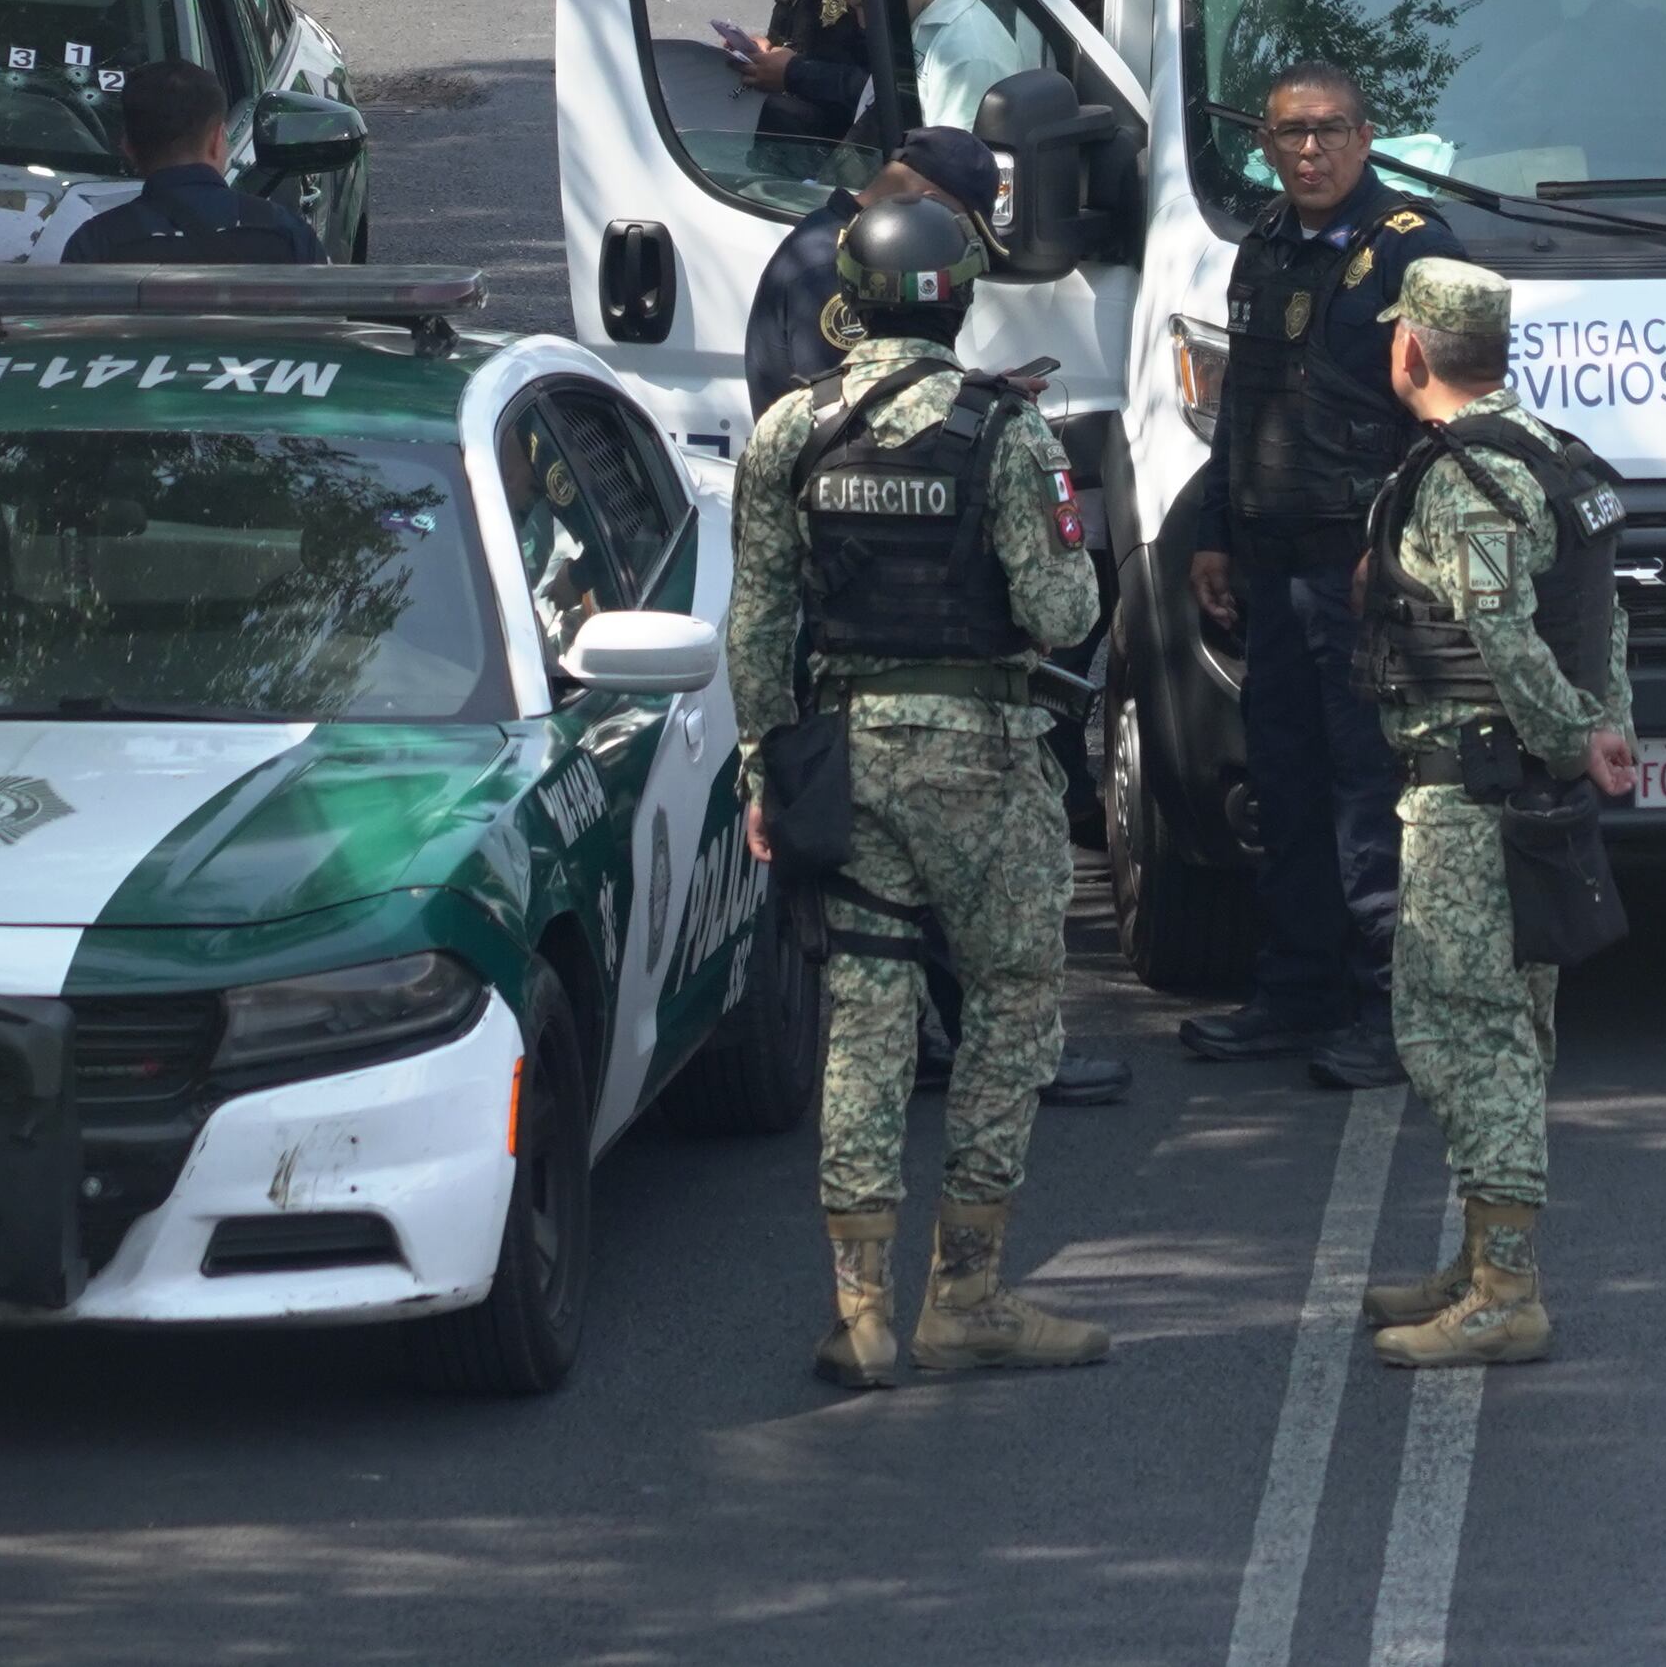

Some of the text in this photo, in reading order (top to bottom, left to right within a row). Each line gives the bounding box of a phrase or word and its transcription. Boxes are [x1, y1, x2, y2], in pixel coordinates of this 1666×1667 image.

[13, 49, 32, 68] 3
[71, 47, 86, 64] 1
[102, 71, 122, 90] 2
[819, 475, 946, 514] EJÉRCITO
